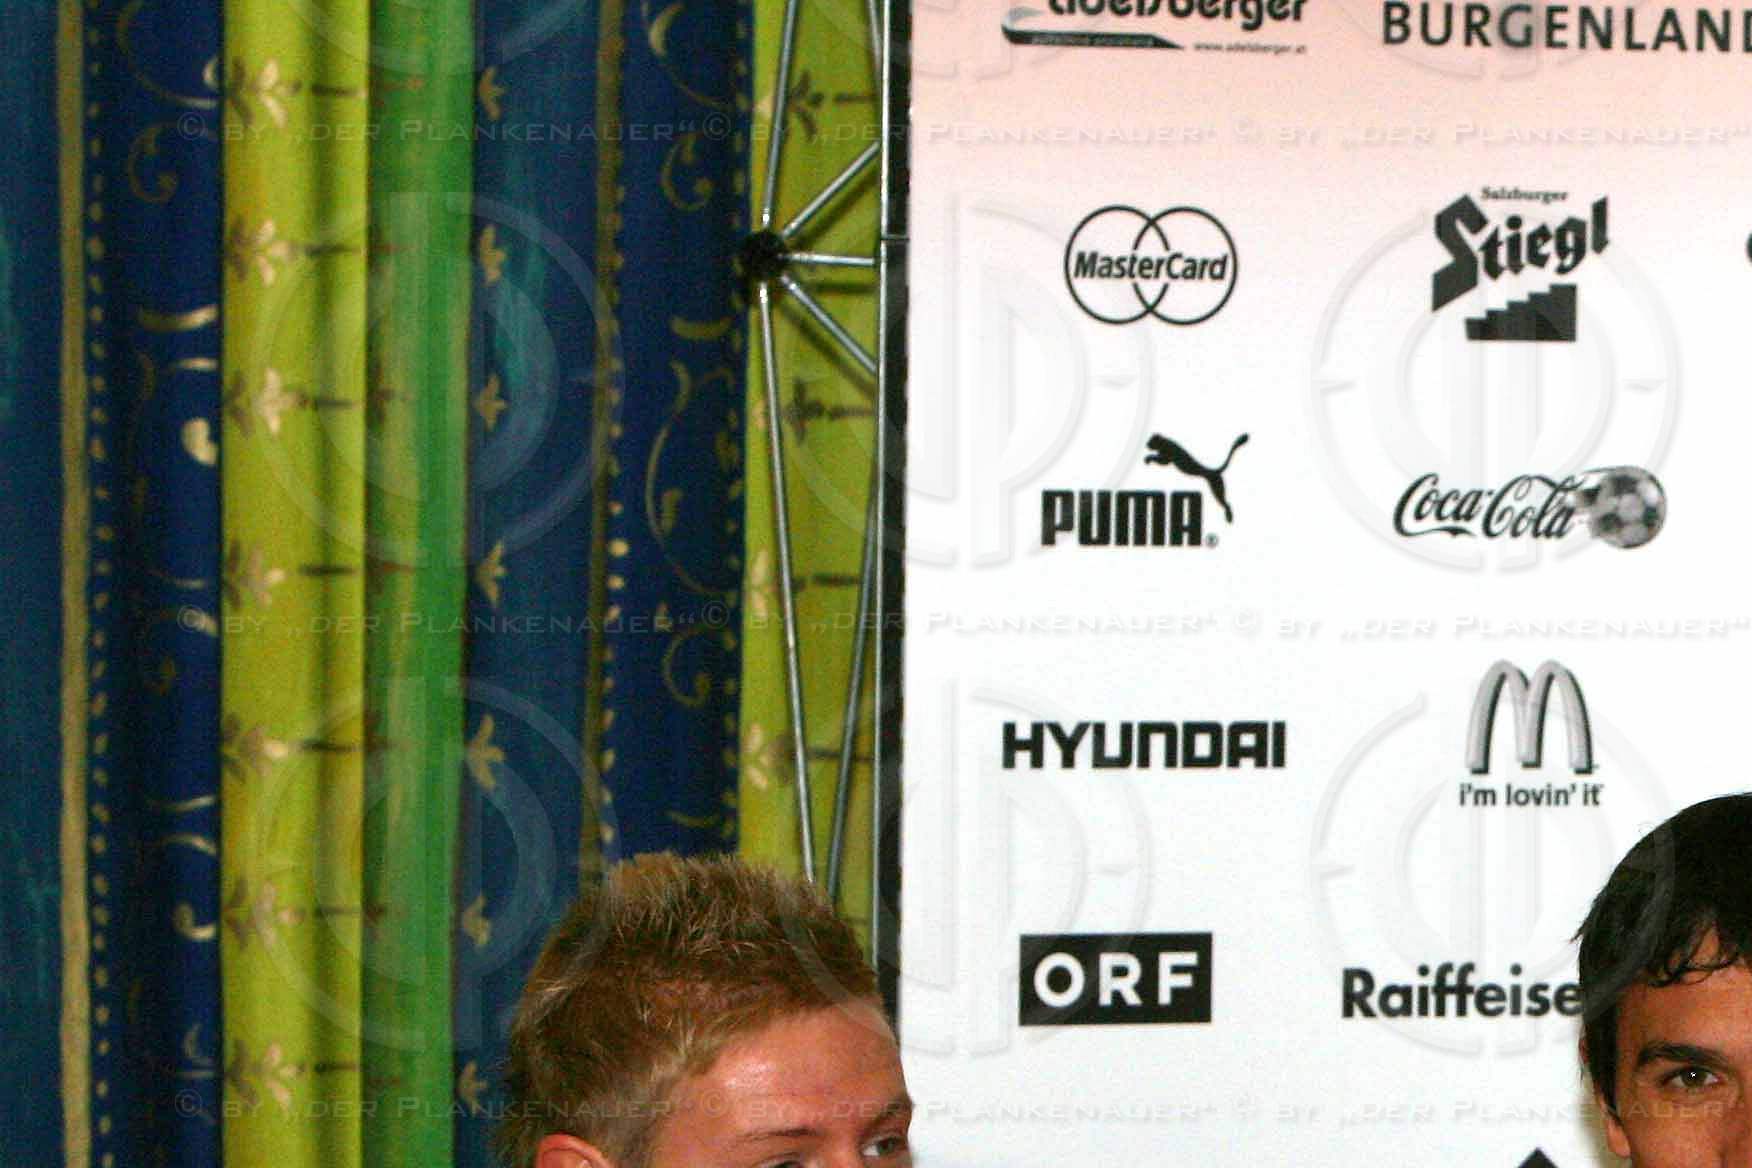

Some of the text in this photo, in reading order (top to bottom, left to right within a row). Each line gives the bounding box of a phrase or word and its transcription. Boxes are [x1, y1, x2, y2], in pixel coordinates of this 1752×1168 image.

[1073, 248, 1229, 282] MasterCard
[1431, 193, 1610, 312] Stiegl
[1041, 489, 1203, 547] PUMA
[1002, 721, 1286, 769] HYUNDAI
[1459, 783, 1497, 806] i'm
[1506, 783, 1576, 807] lovin'
[1032, 951, 1200, 1008] ORF
[1341, 963, 1582, 1019] Raiffeise
